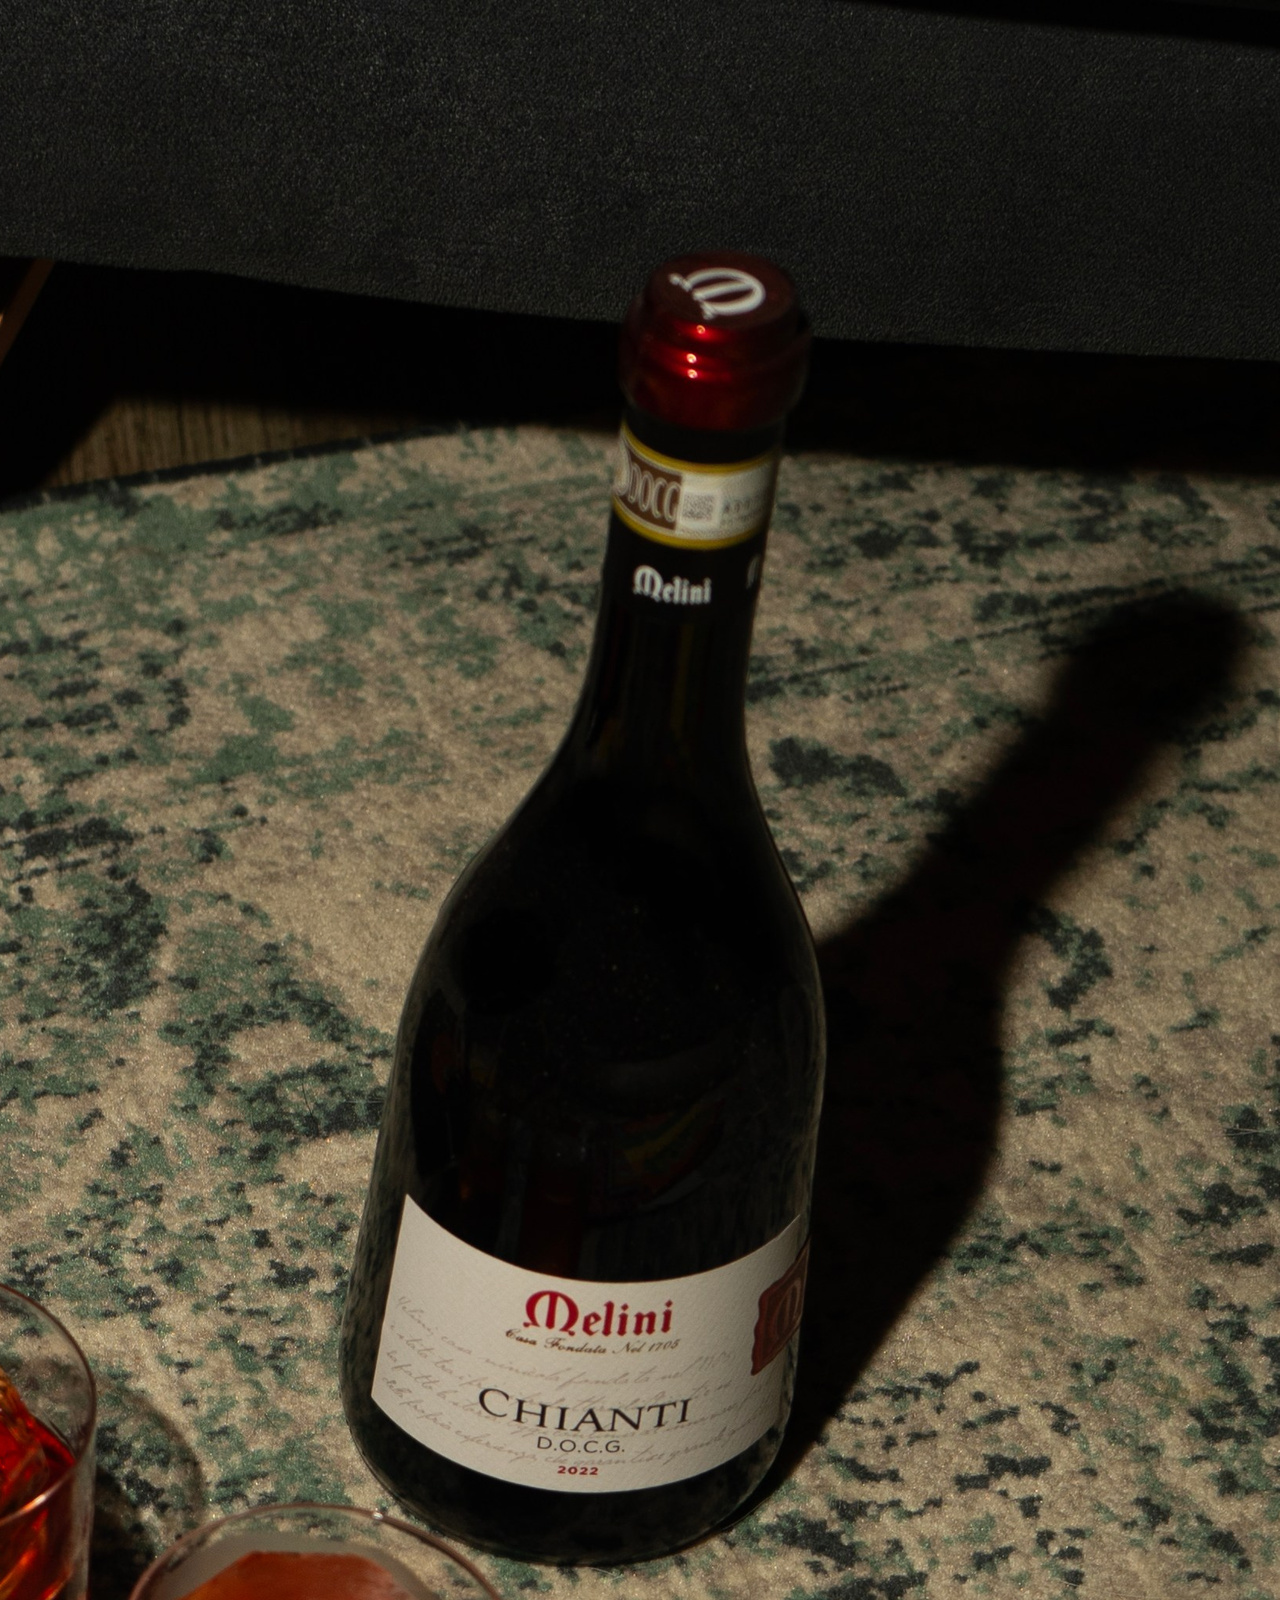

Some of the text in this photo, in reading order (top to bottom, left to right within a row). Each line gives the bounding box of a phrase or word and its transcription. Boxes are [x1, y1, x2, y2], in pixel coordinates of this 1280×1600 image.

[632, 564, 713, 606] Melini
[523, 1290, 673, 1337] Melini
[504, 1328, 538, 1347] Casa
[544, 1337, 608, 1355] Fondata
[647, 1337, 681, 1353] 1705
[478, 1387, 693, 1433] CHIANTI
[536, 1435, 626, 1454] D.O.C.G.
[557, 1465, 599, 1477] 2022
